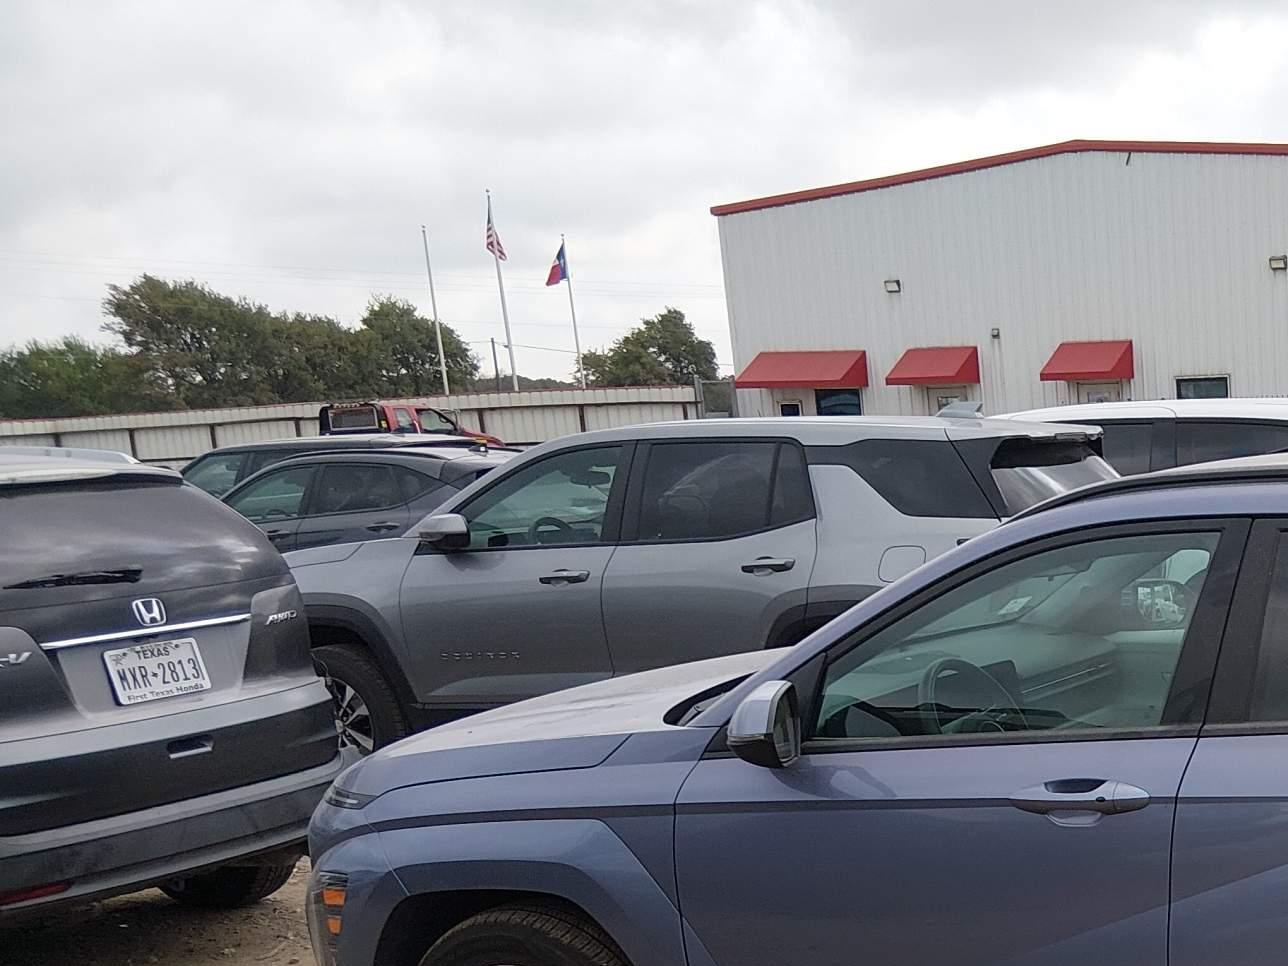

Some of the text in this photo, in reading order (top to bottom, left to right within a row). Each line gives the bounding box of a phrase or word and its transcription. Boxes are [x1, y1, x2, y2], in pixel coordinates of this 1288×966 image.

[135, 646, 171, 660] TEXAS
[127, 683, 204, 702] First Texas Honda
